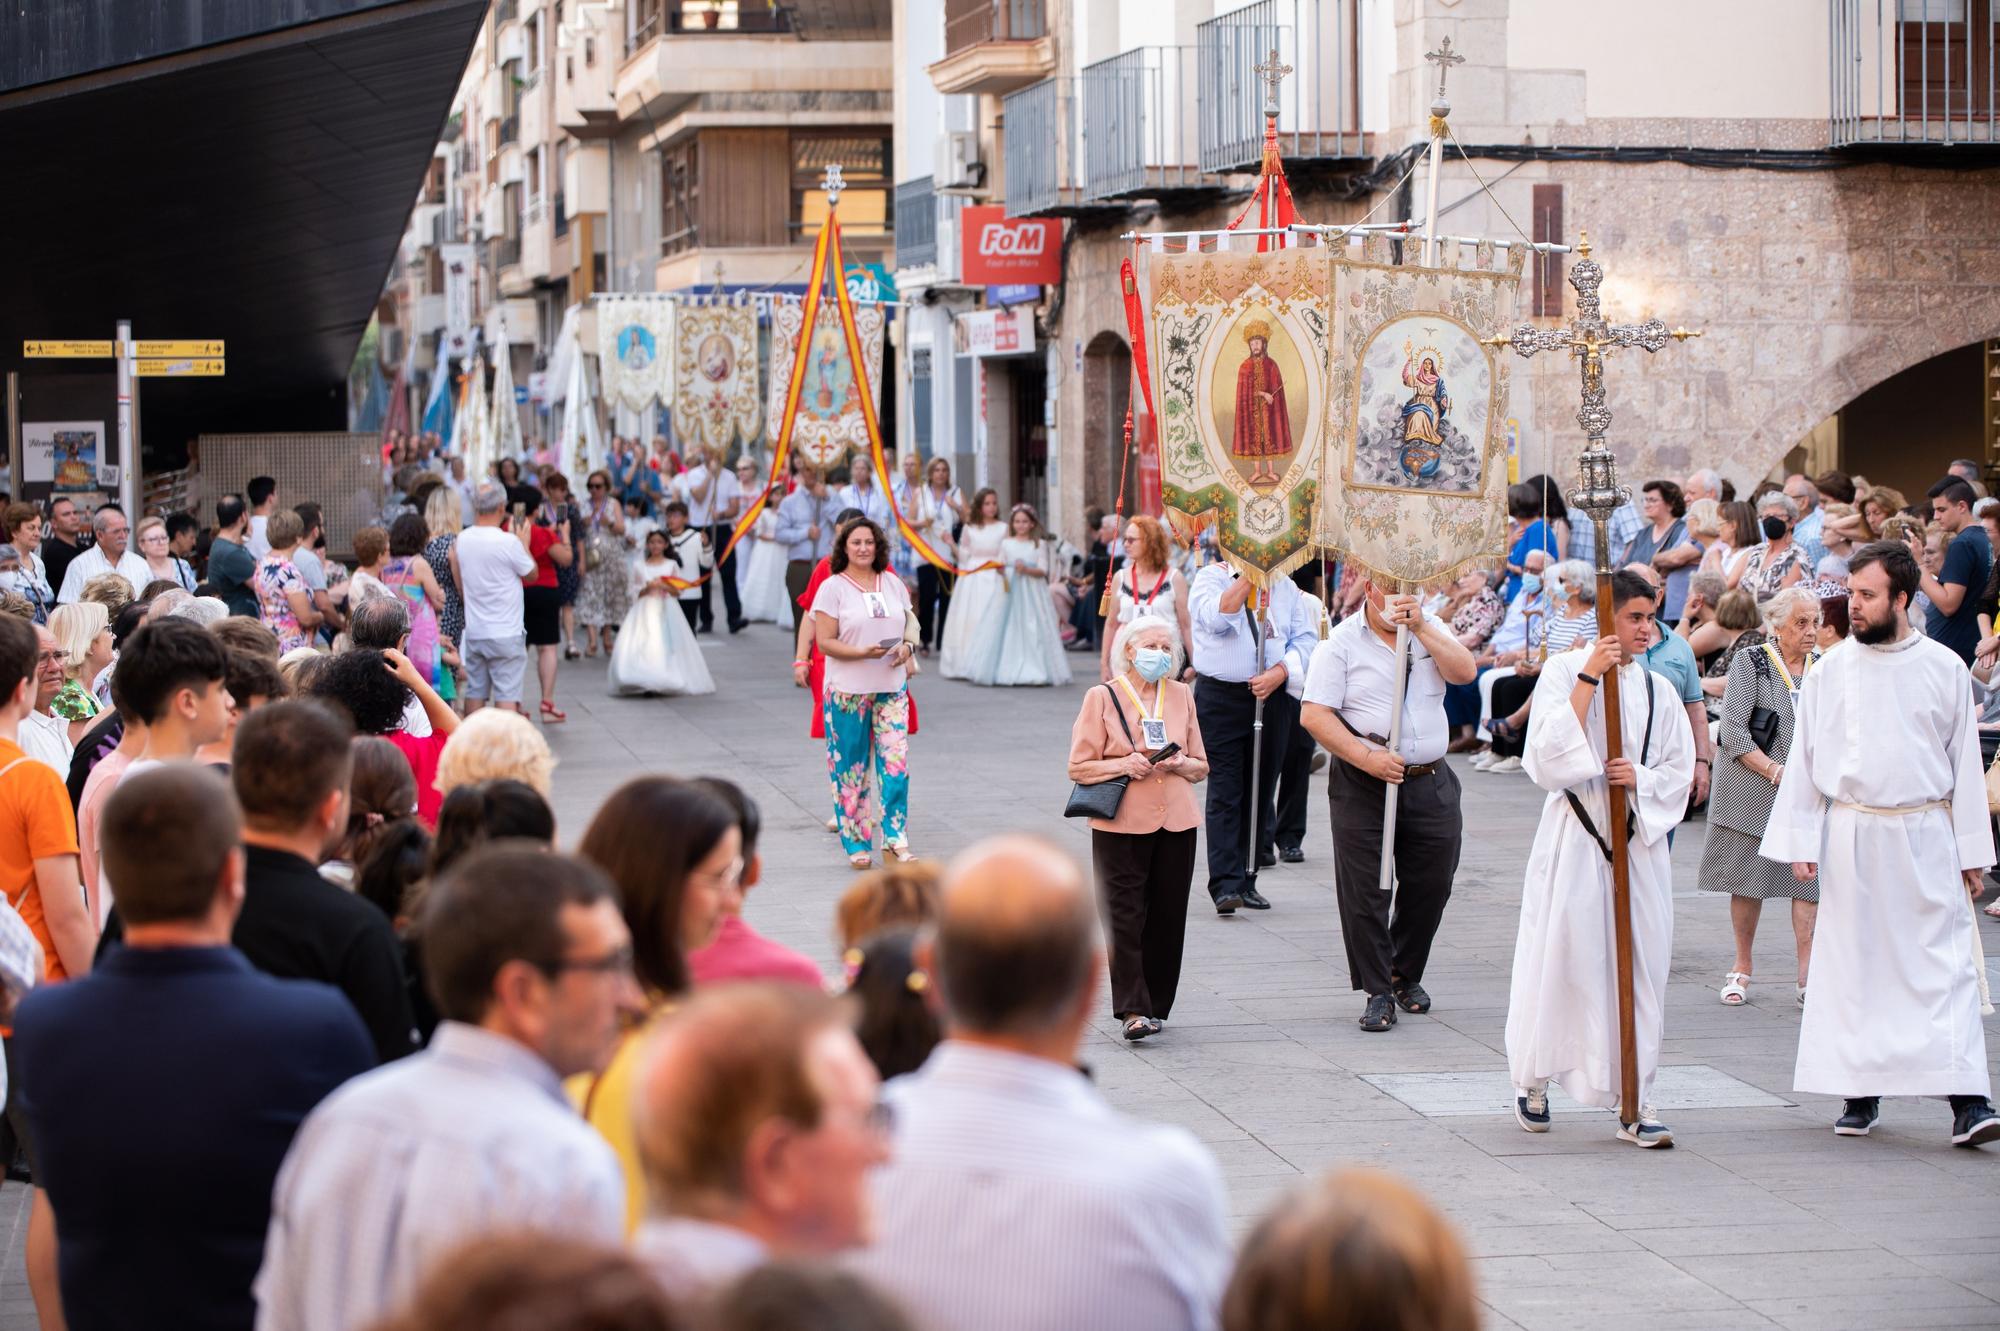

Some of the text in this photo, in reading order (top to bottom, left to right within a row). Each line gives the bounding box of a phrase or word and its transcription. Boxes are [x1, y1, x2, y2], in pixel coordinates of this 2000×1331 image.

[981, 225, 1043, 254] FoM
[1224, 464, 1304, 495] ECCE HOMO
